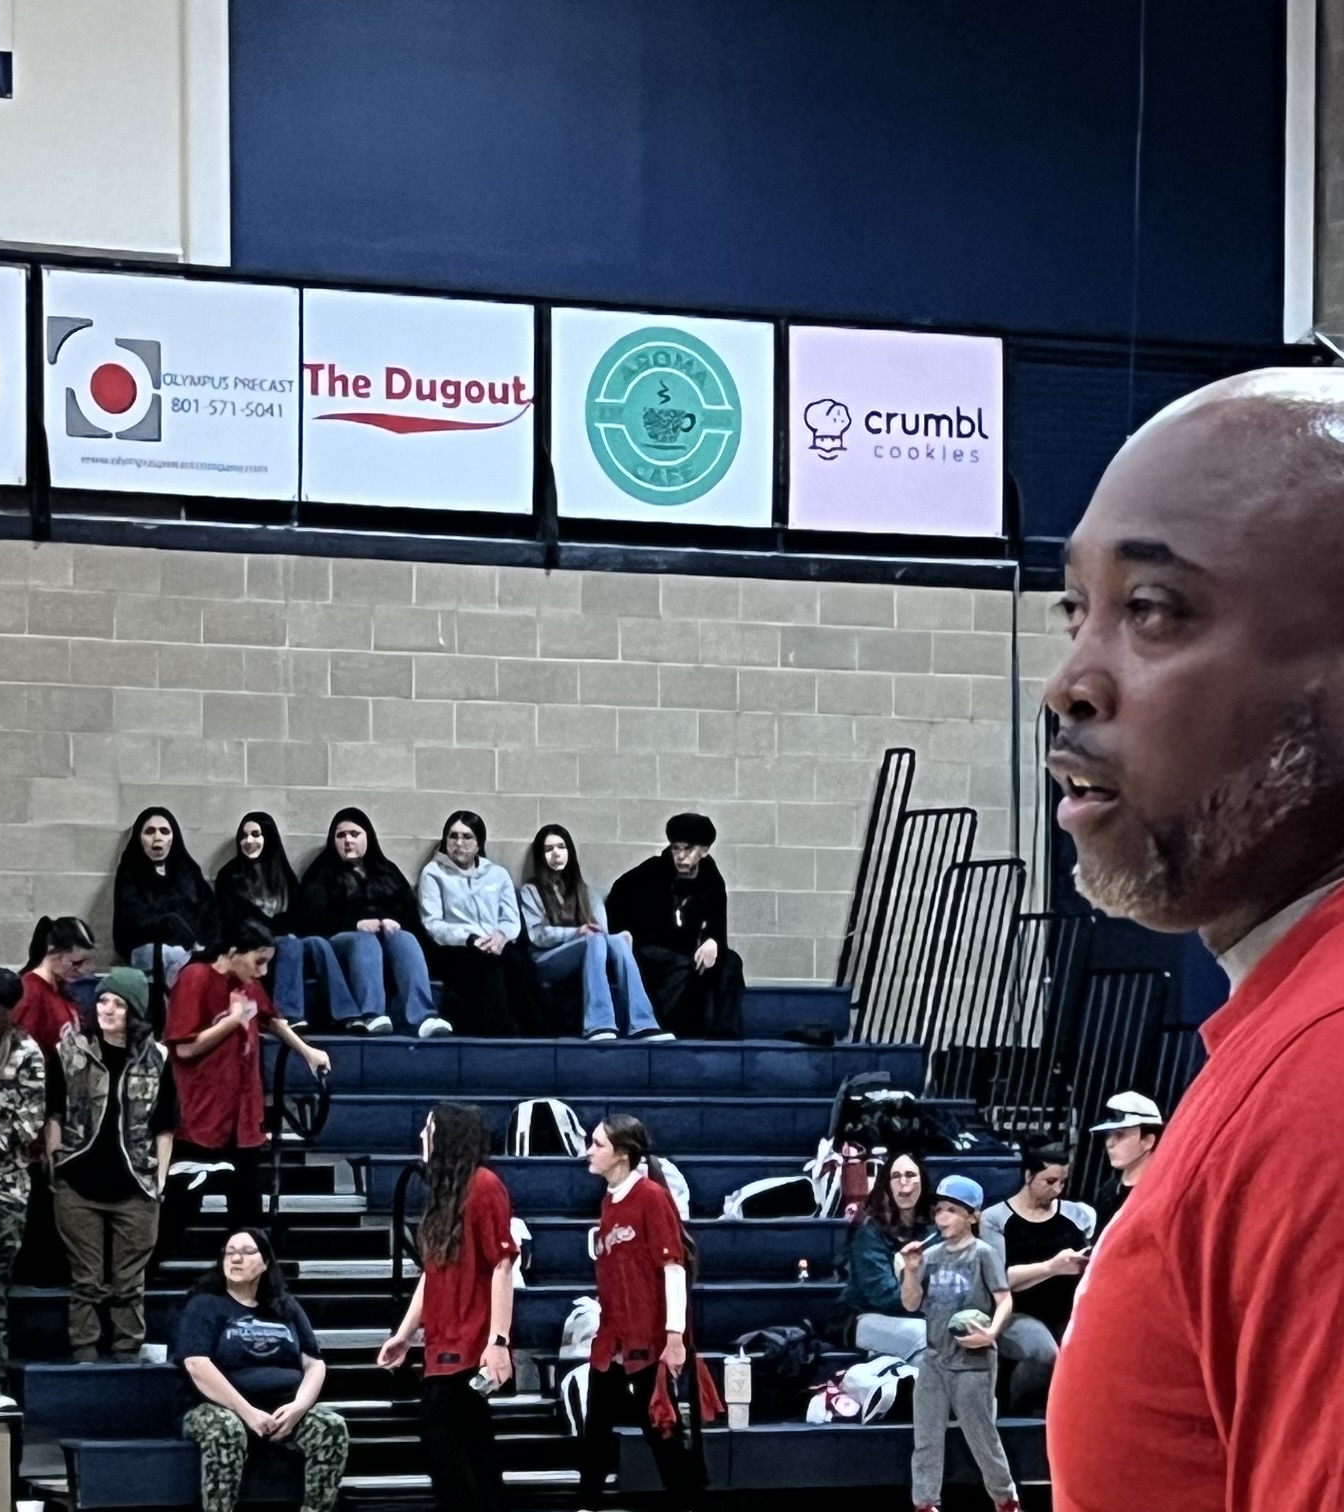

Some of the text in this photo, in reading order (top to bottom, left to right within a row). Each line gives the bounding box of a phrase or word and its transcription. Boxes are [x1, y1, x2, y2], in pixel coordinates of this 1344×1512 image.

[162, 372, 295, 393] OLYMPUS PRECAST
[304, 363, 532, 408] The Dugout
[171, 396, 284, 418] 801-571-5041
[864, 406, 989, 439] crumbl
[874, 444, 979, 463] cookies
